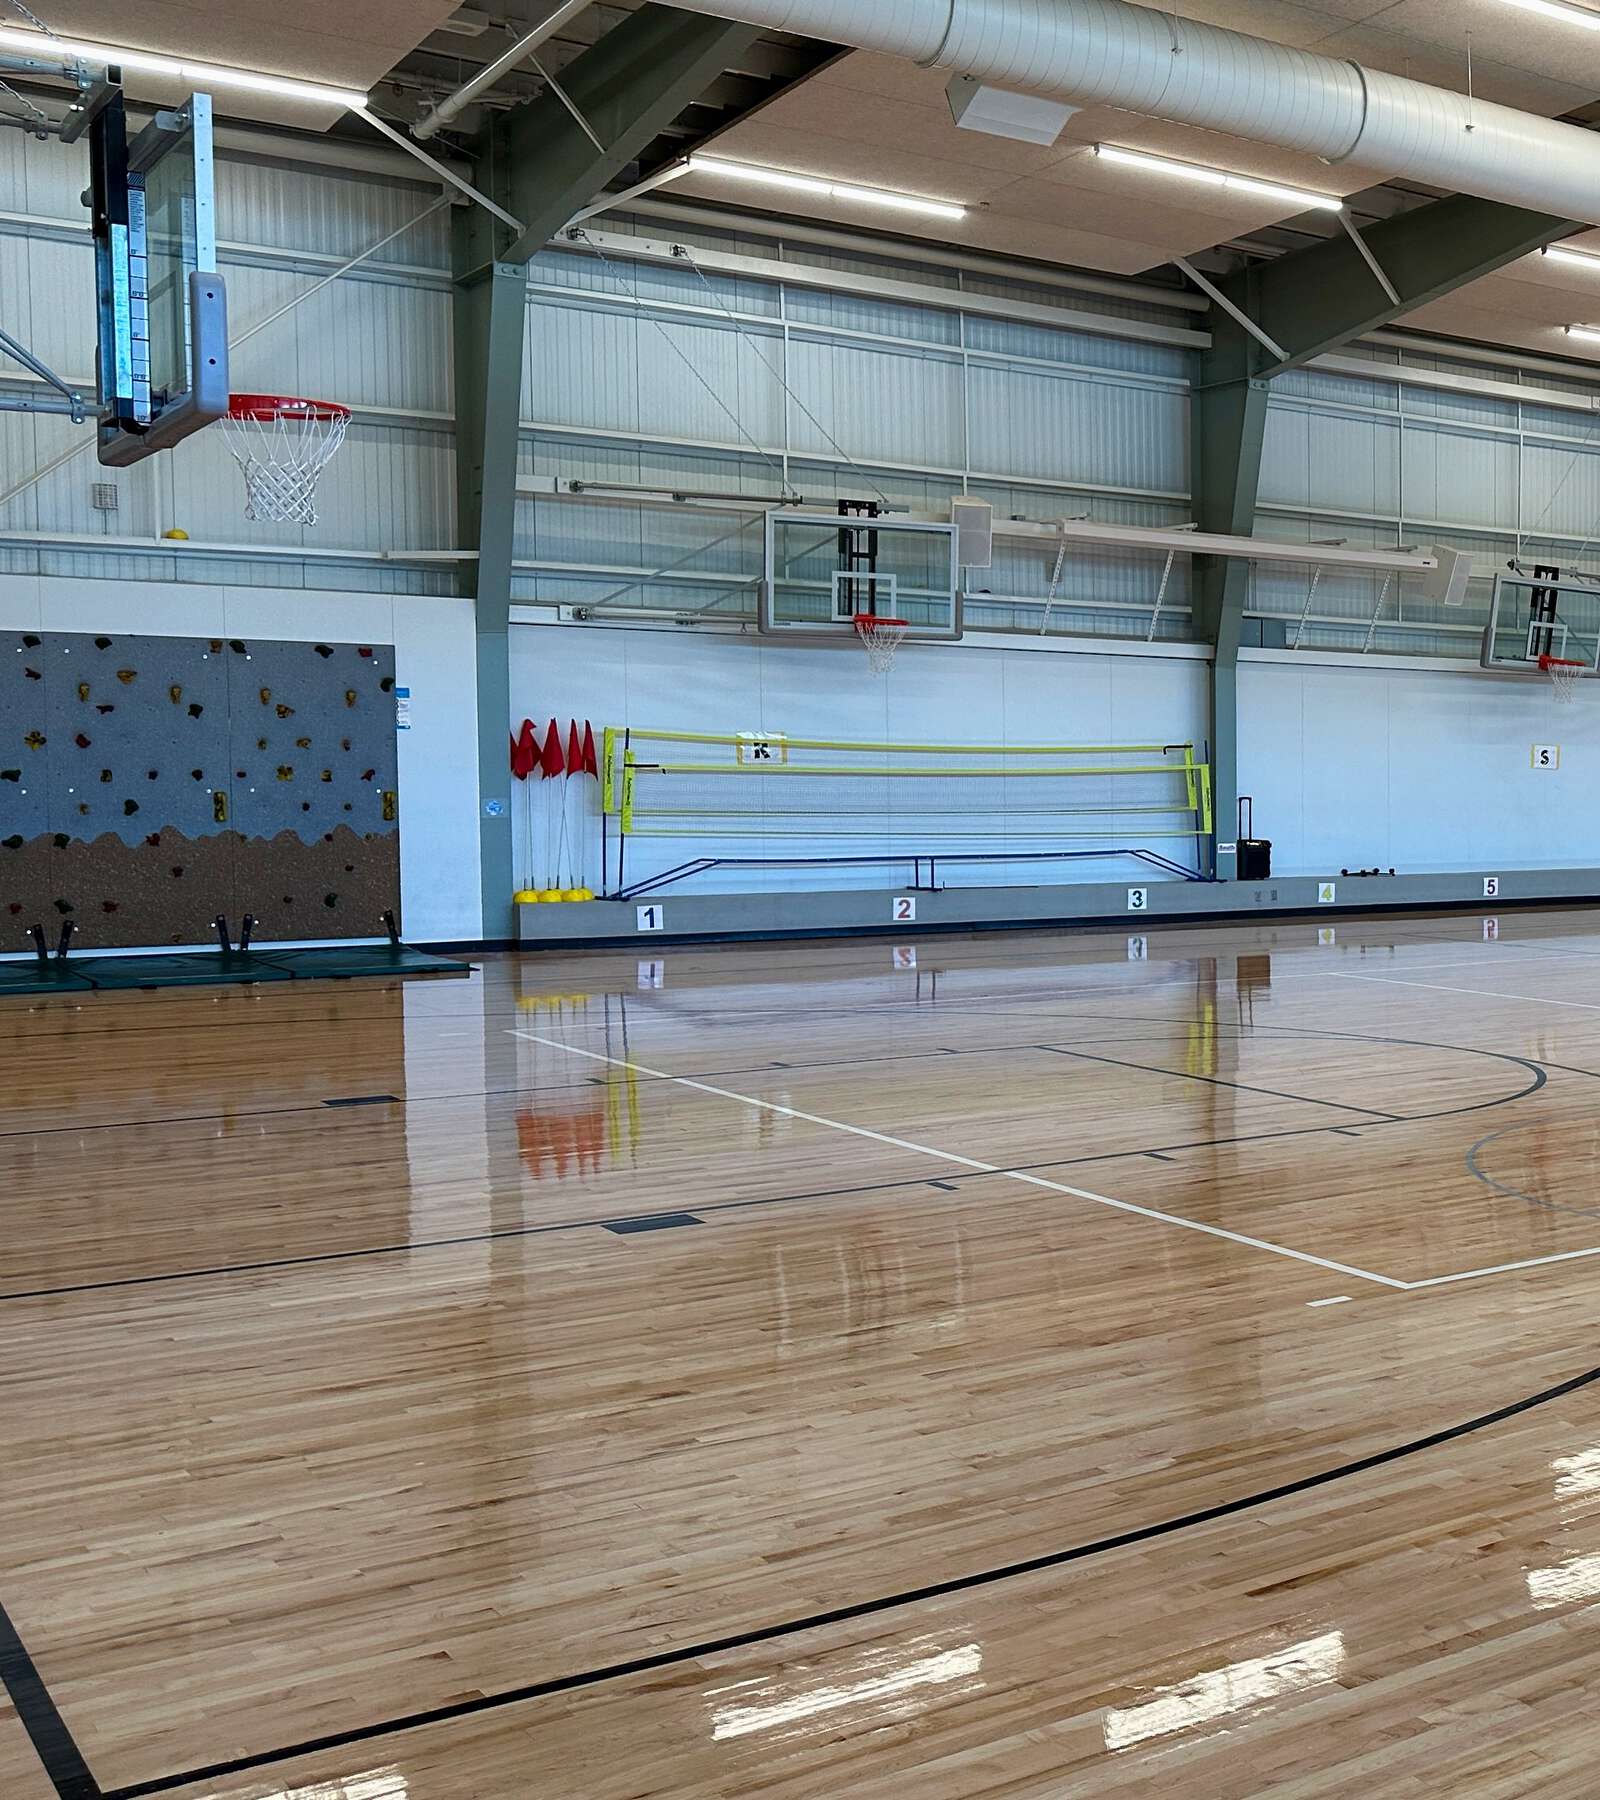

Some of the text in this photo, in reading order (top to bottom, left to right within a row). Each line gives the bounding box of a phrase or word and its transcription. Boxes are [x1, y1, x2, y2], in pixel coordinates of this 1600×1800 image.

[753, 742, 771, 759] K
[1540, 749, 1550, 765] S
[1321, 884, 1332, 900] 4
[1487, 879, 1496, 895] 5
[1131, 890, 1144, 907] 3
[644, 907, 655, 928] 1
[898, 899, 911, 919] 2
